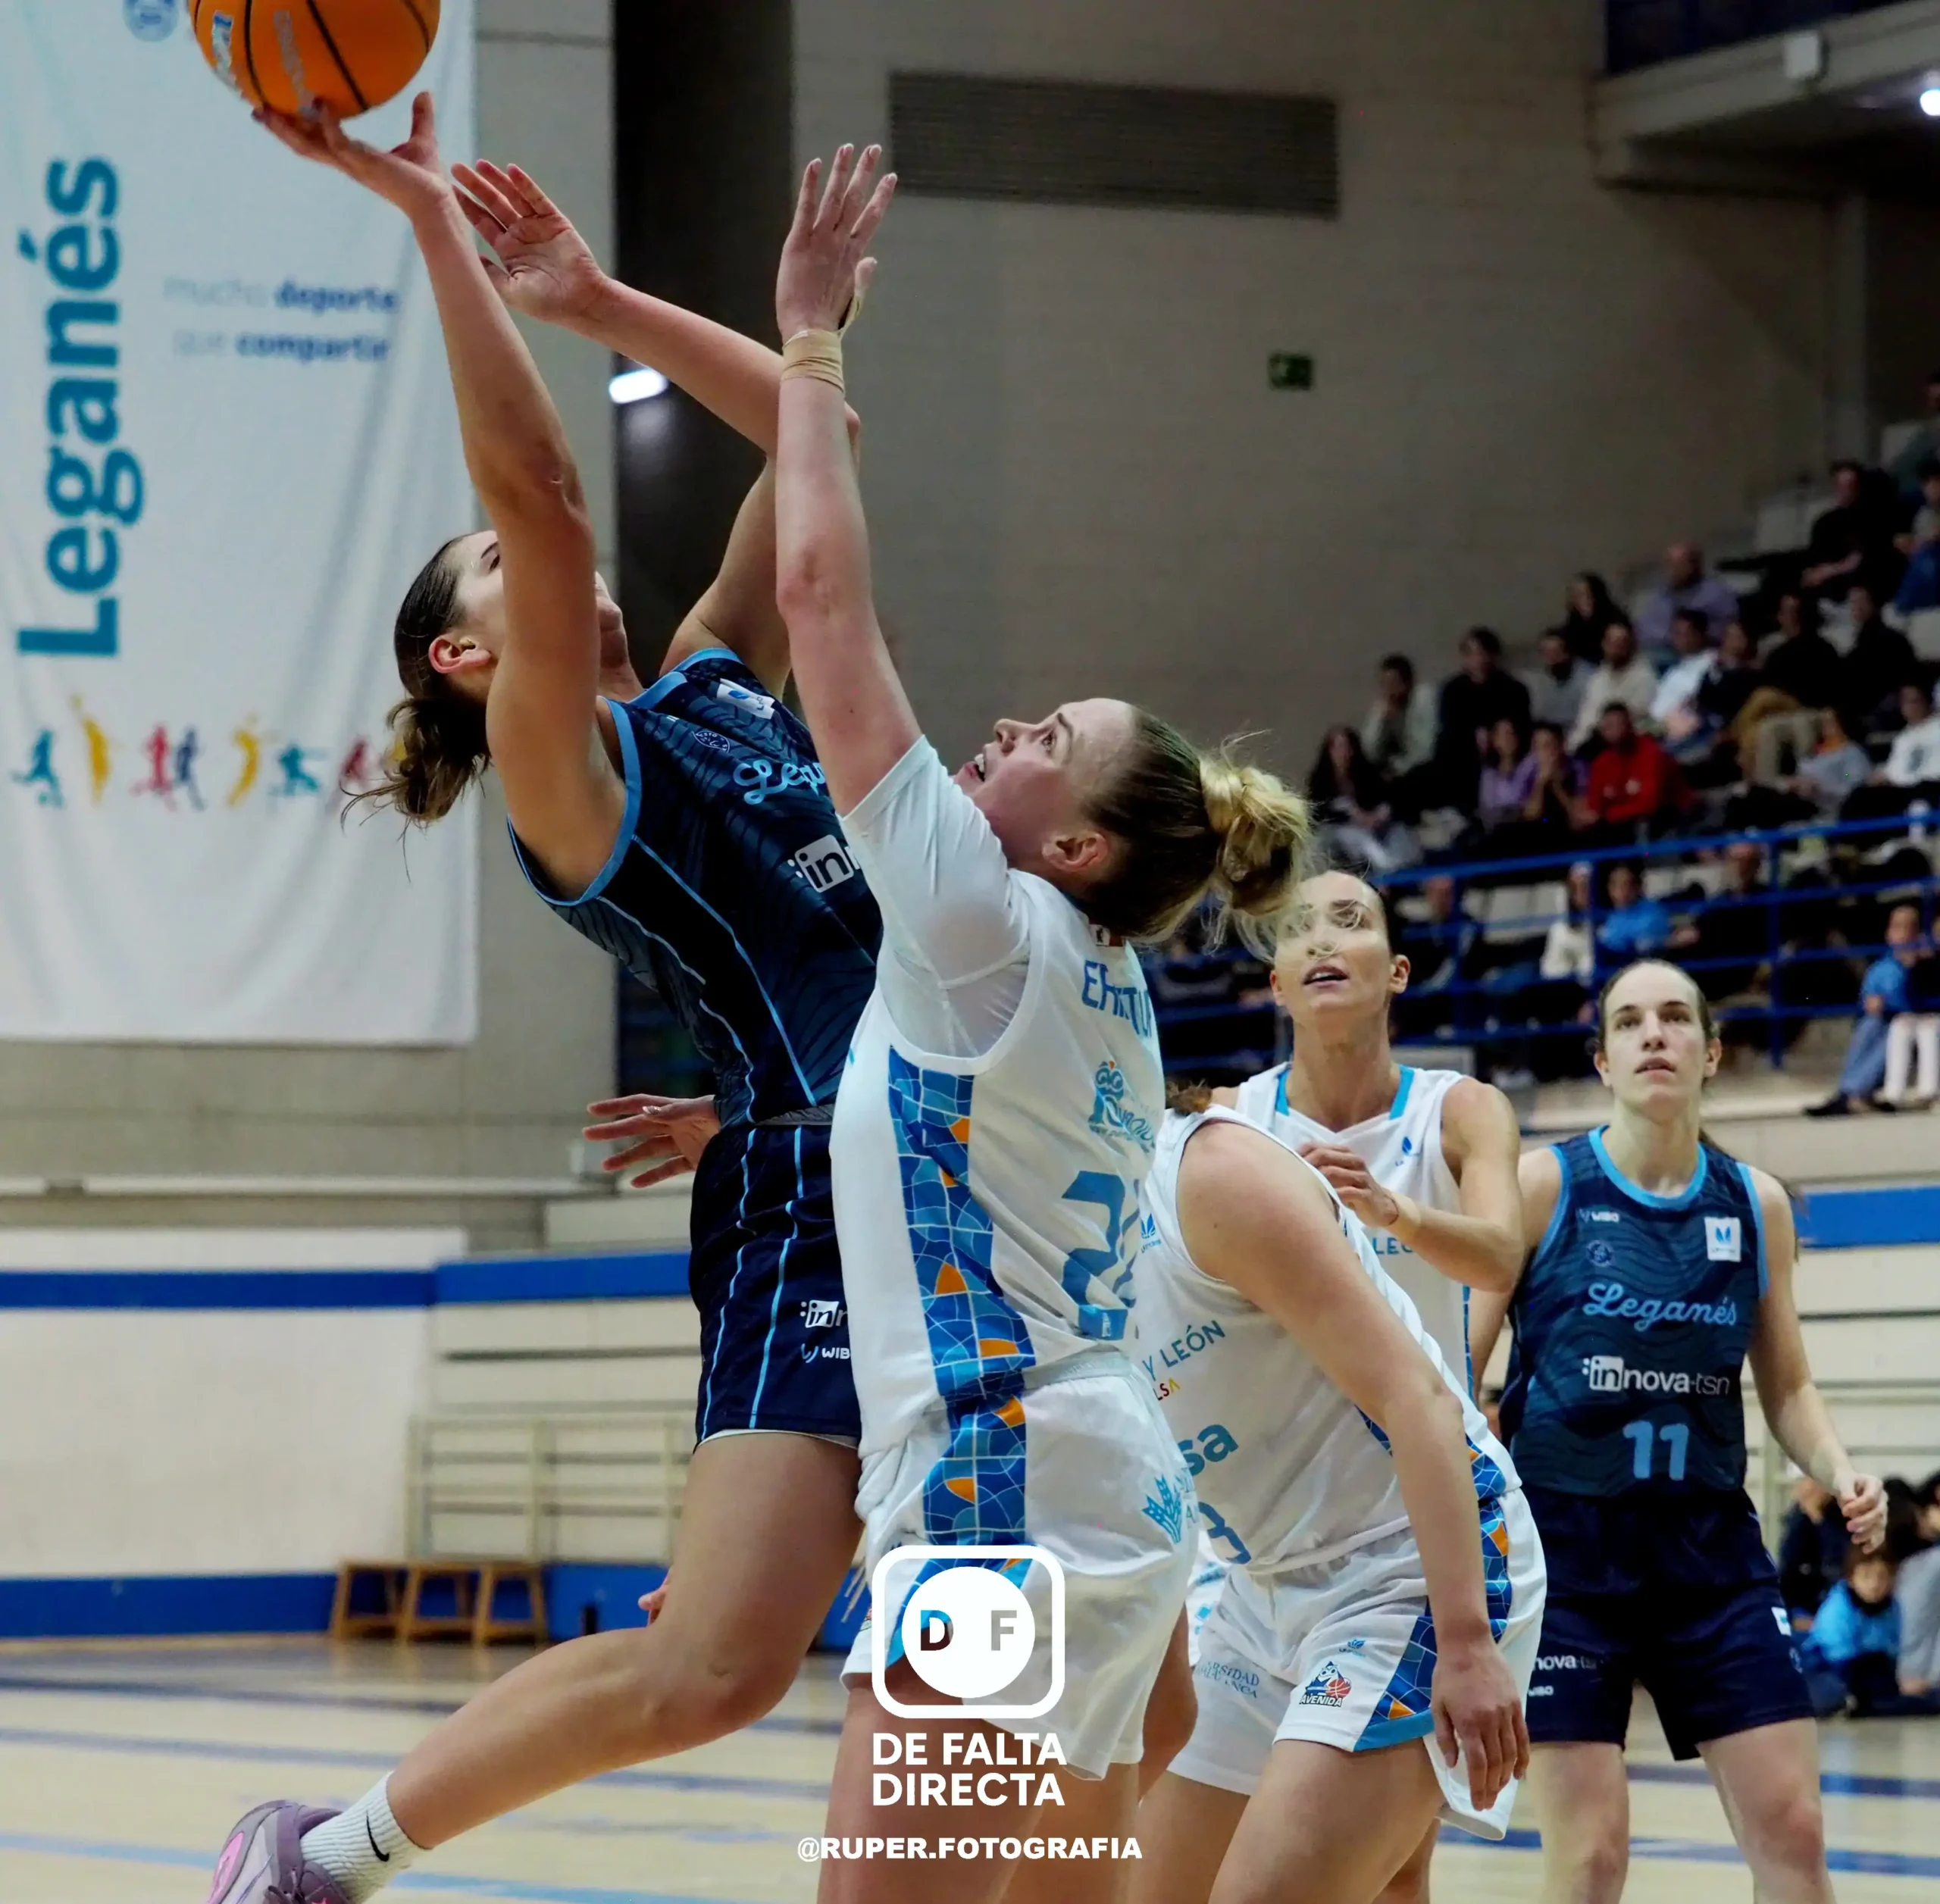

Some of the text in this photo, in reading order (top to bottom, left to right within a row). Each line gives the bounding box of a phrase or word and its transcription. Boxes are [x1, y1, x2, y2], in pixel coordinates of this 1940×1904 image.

[17, 156, 144, 657] Leganés
[1582, 1283, 1737, 1332] Leganés
[1159, 1320, 1225, 1368] LEÓN
[1623, 1419, 1689, 1481] 11
[1300, 1693, 1344, 1707] AVENIDA
